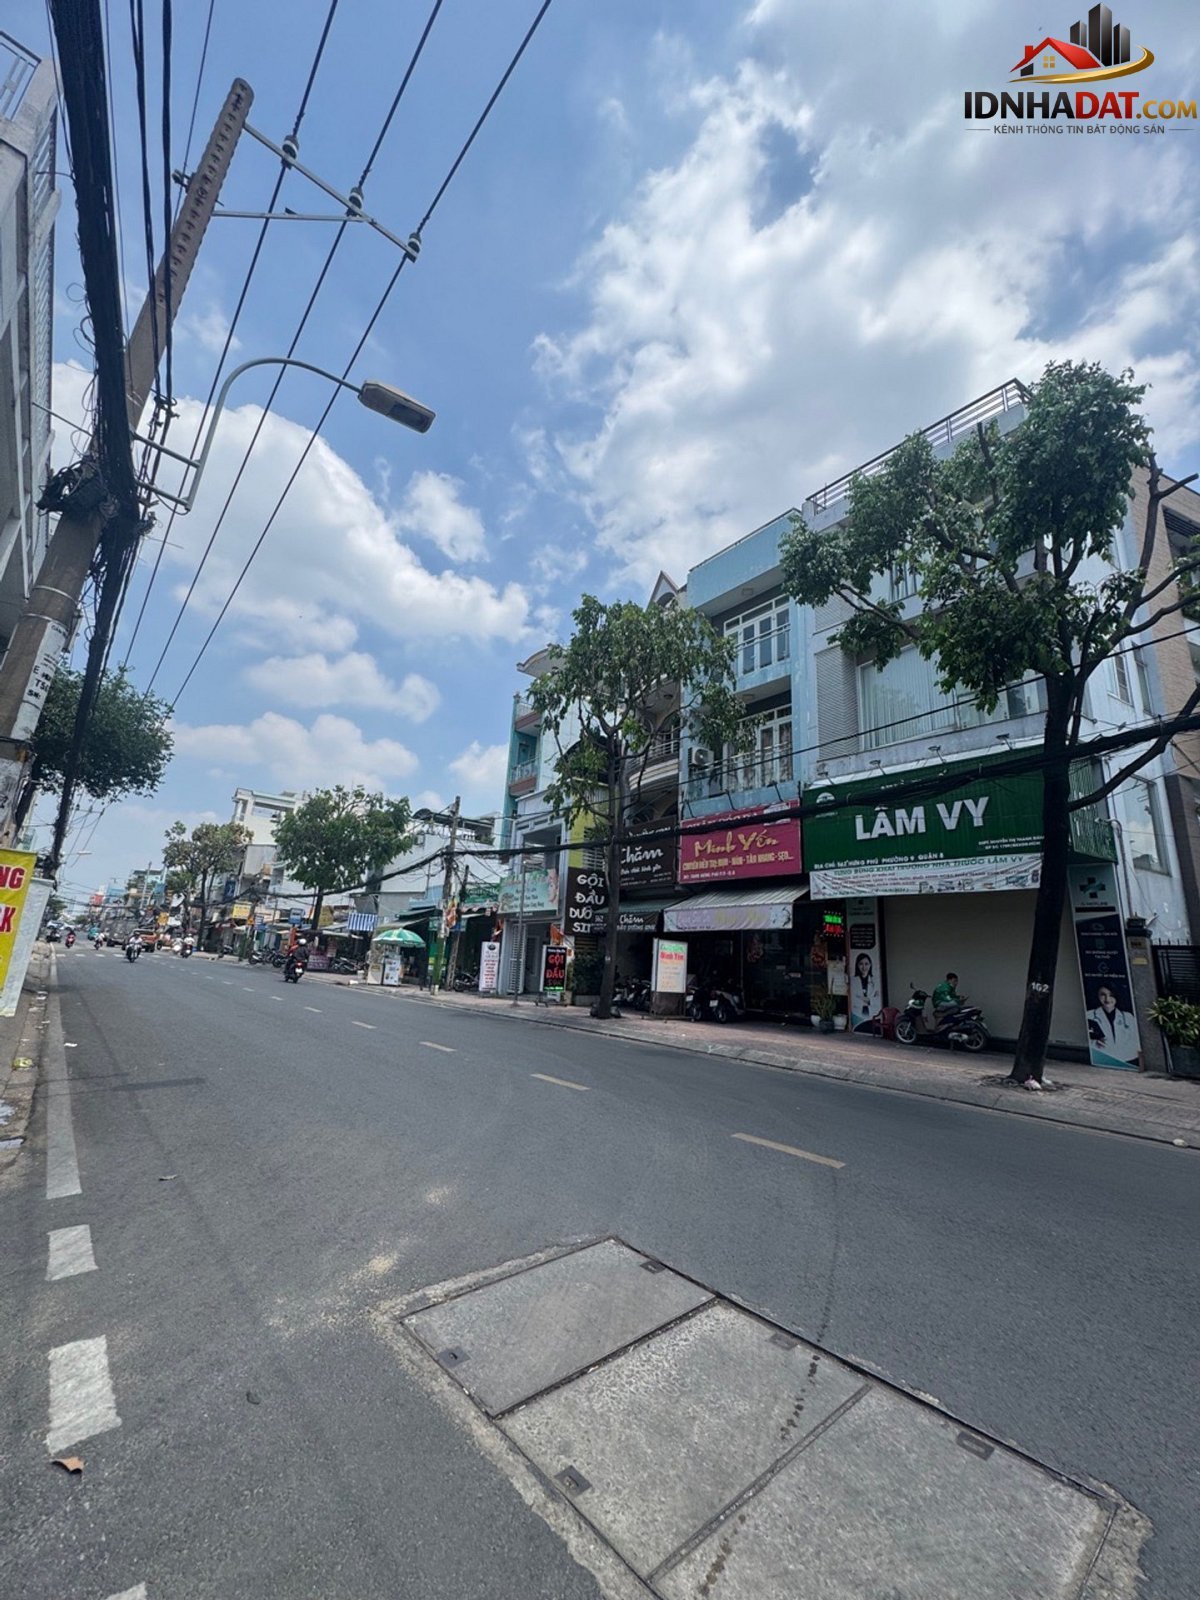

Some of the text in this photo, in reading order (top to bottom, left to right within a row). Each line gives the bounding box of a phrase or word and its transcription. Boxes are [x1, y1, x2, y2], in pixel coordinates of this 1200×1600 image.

[855, 796, 990, 841] LÂM VY
[694, 830, 737, 858] Minh
[738, 829, 779, 852] Yến
[577, 873, 604, 889] GỘI
[574, 889, 605, 905] ĐẦU
